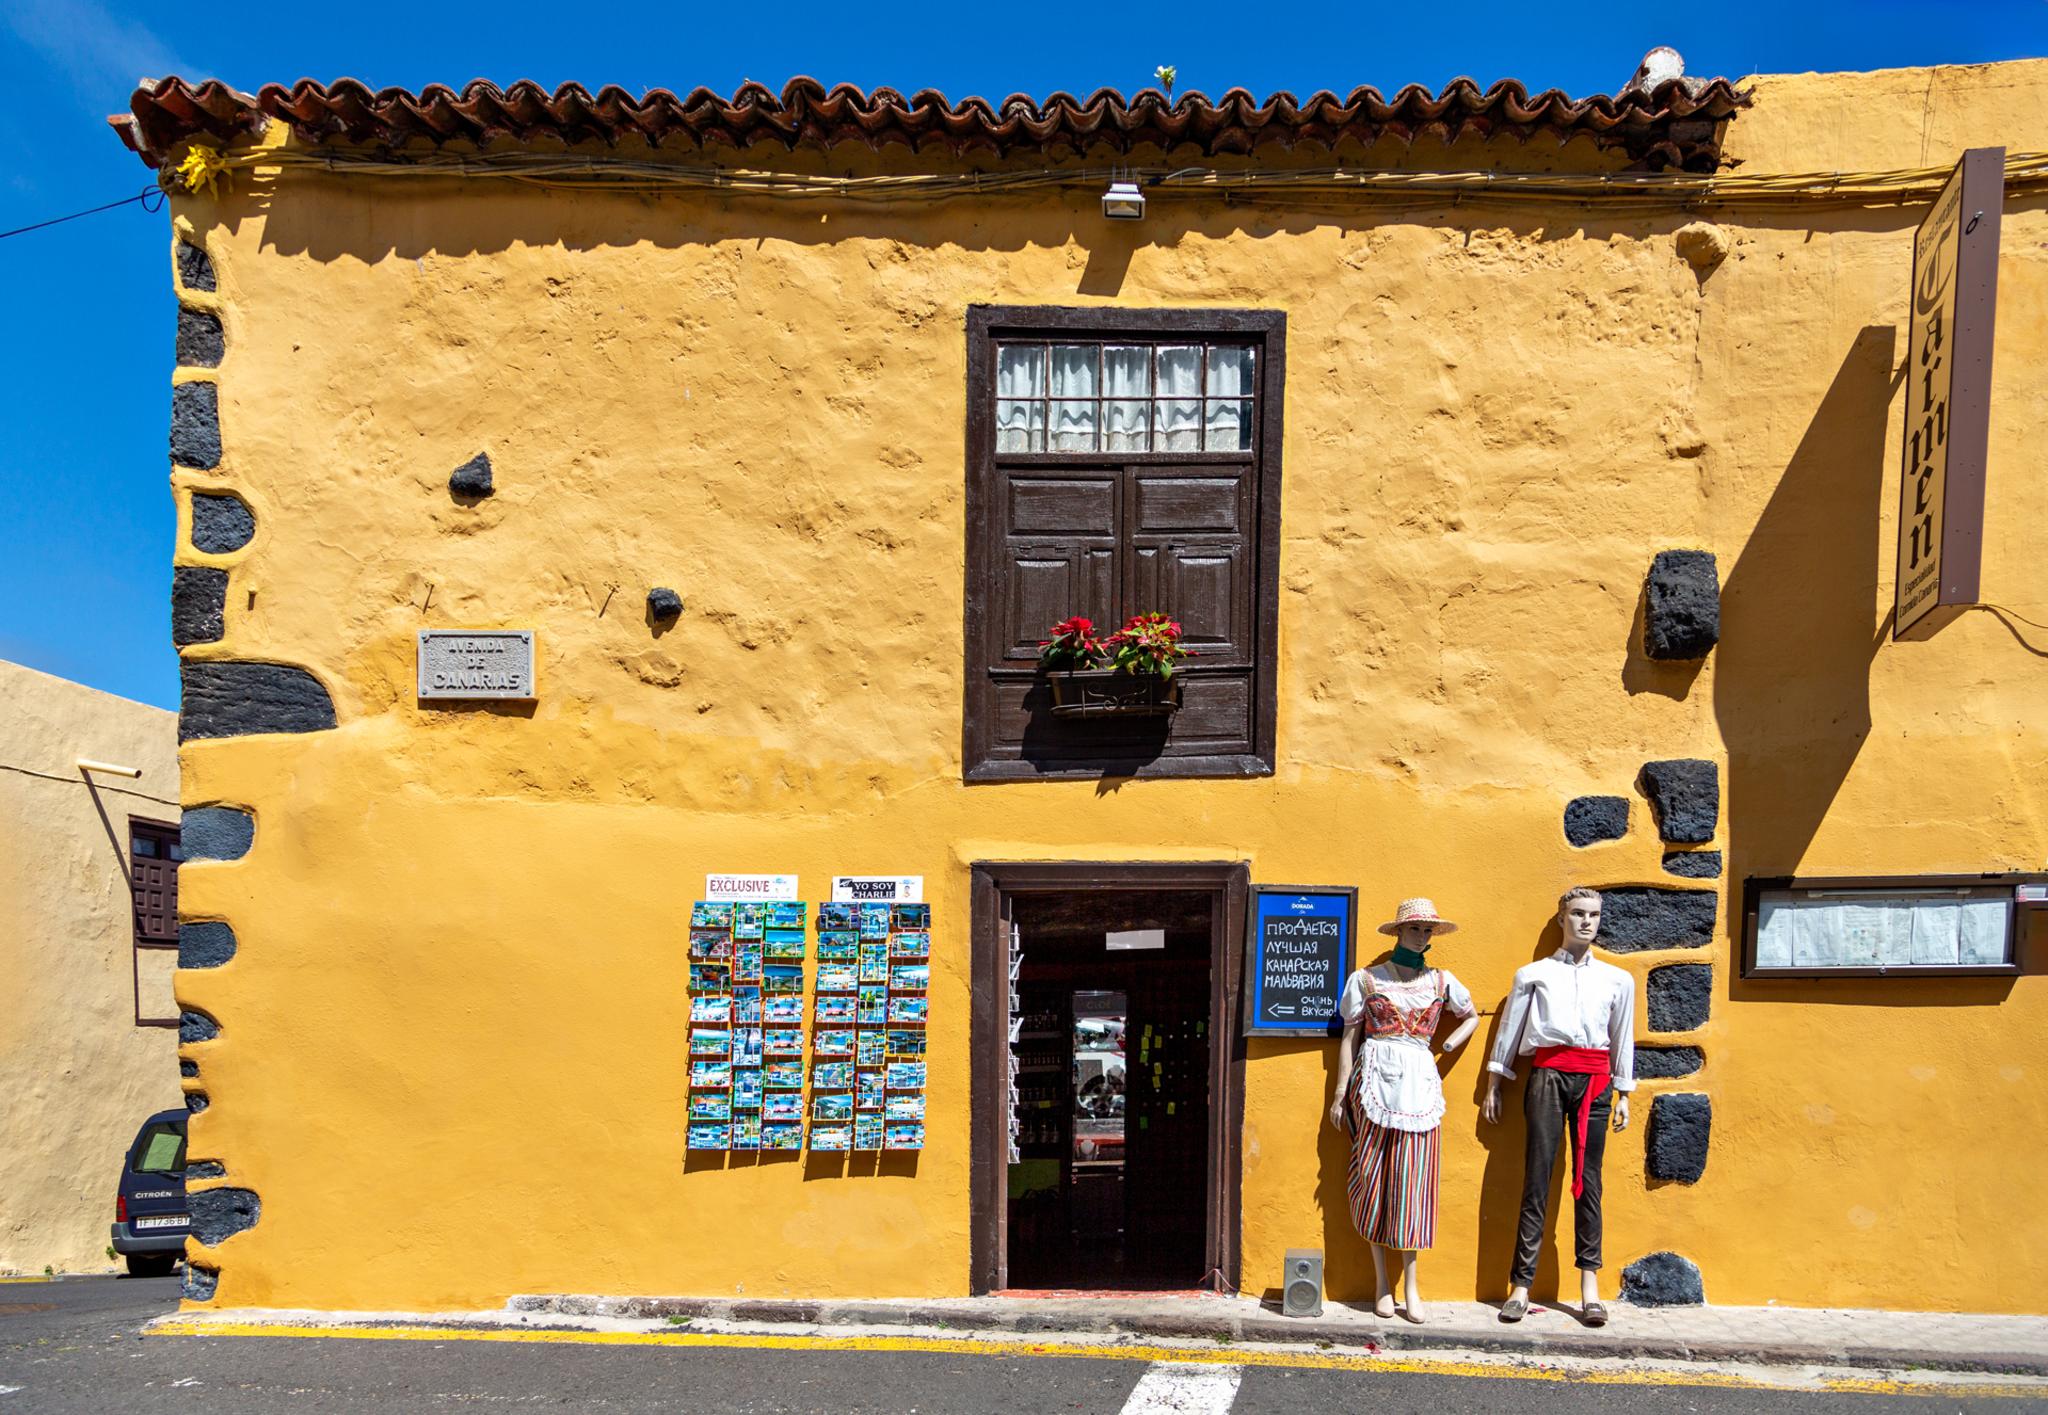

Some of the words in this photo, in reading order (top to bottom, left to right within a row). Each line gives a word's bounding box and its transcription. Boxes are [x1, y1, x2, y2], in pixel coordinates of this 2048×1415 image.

[449, 640, 504, 654] AVENIDA
[467, 656, 485, 670] DE
[433, 672, 520, 690] CANARIAS
[709, 879, 770, 893] EXCLUSIVE
[854, 882, 869, 890] YO
[872, 882, 893, 890] SOY
[852, 890, 896, 899] CHARLIE
[1266, 918, 1338, 937] ПРОДАЕТСЯ
[1265, 940, 1318, 955] ЛУЧШАЯ
[1266, 957, 1330, 973] КАНАРСКАЯ
[1264, 972, 1325, 991] МАЛЬВАЗИЯ
